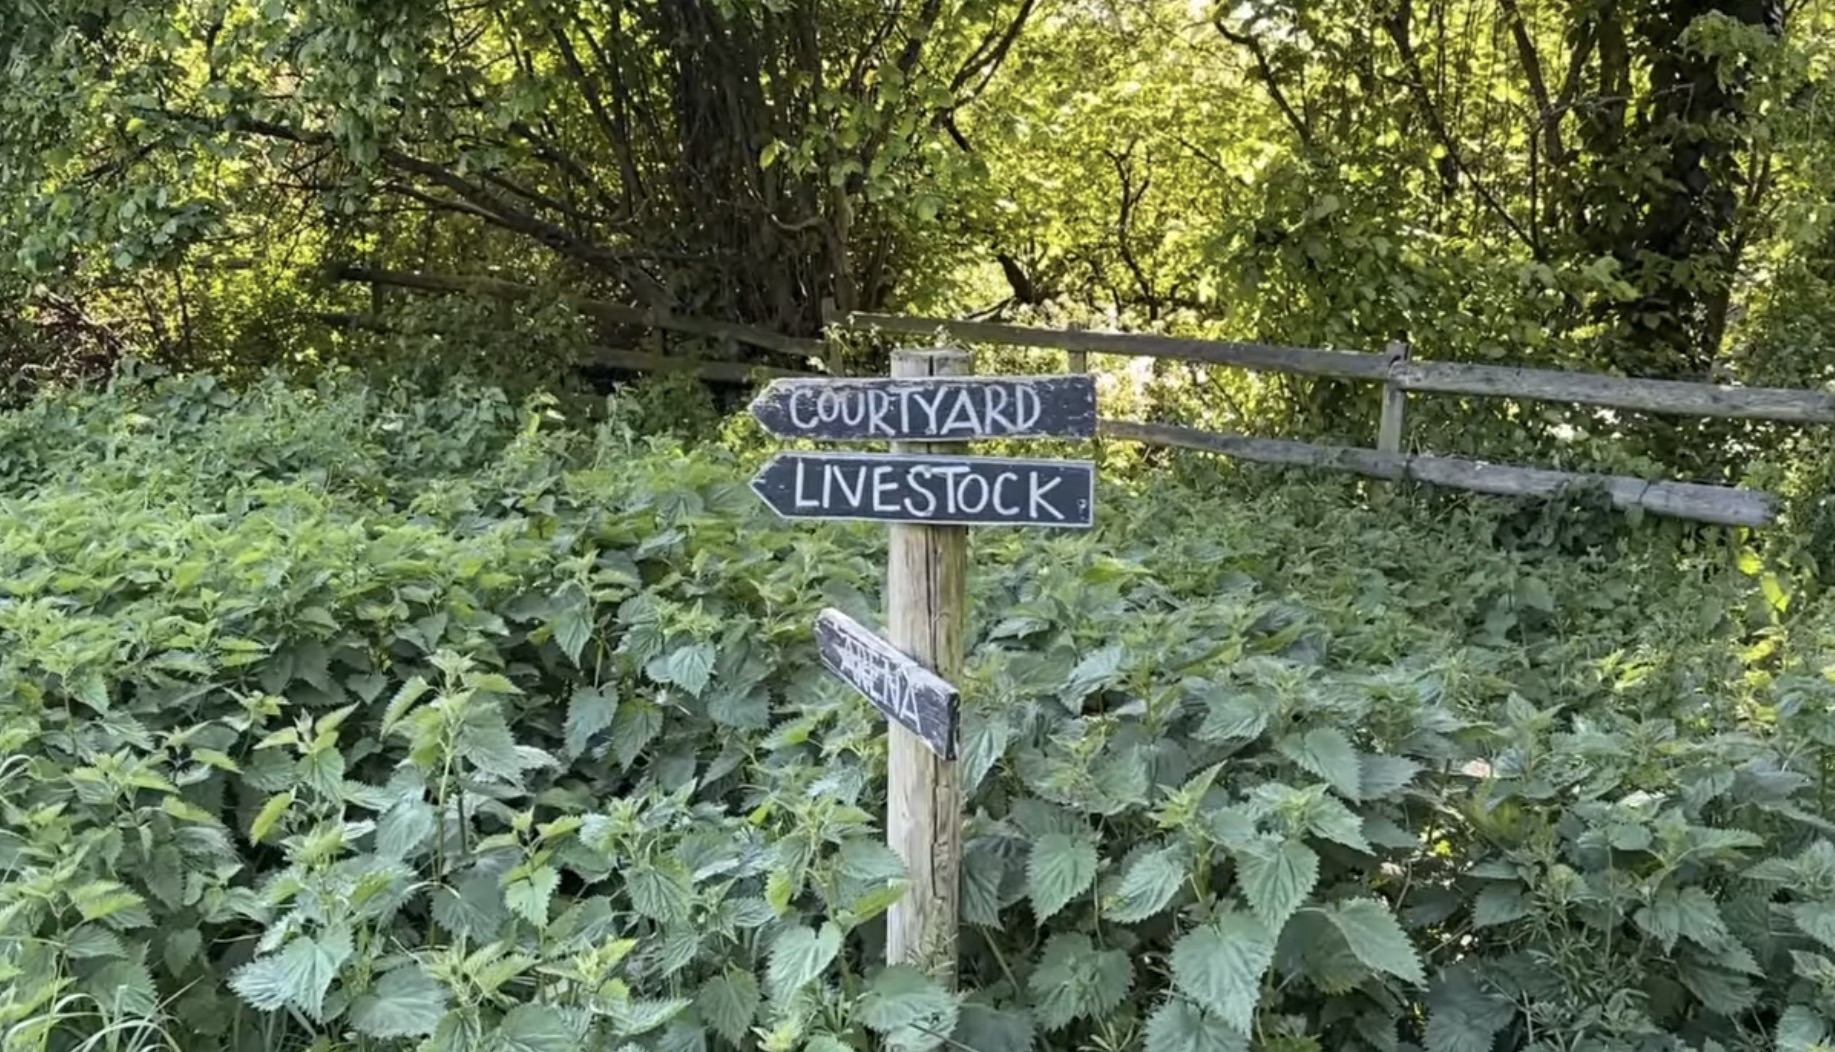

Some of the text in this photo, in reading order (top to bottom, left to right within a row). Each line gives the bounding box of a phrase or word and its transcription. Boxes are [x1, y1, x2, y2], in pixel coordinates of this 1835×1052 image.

[788, 384, 1042, 435] COURTYARD
[794, 458, 1065, 520] LIVESTOCK
[838, 636, 921, 733] ARENA
